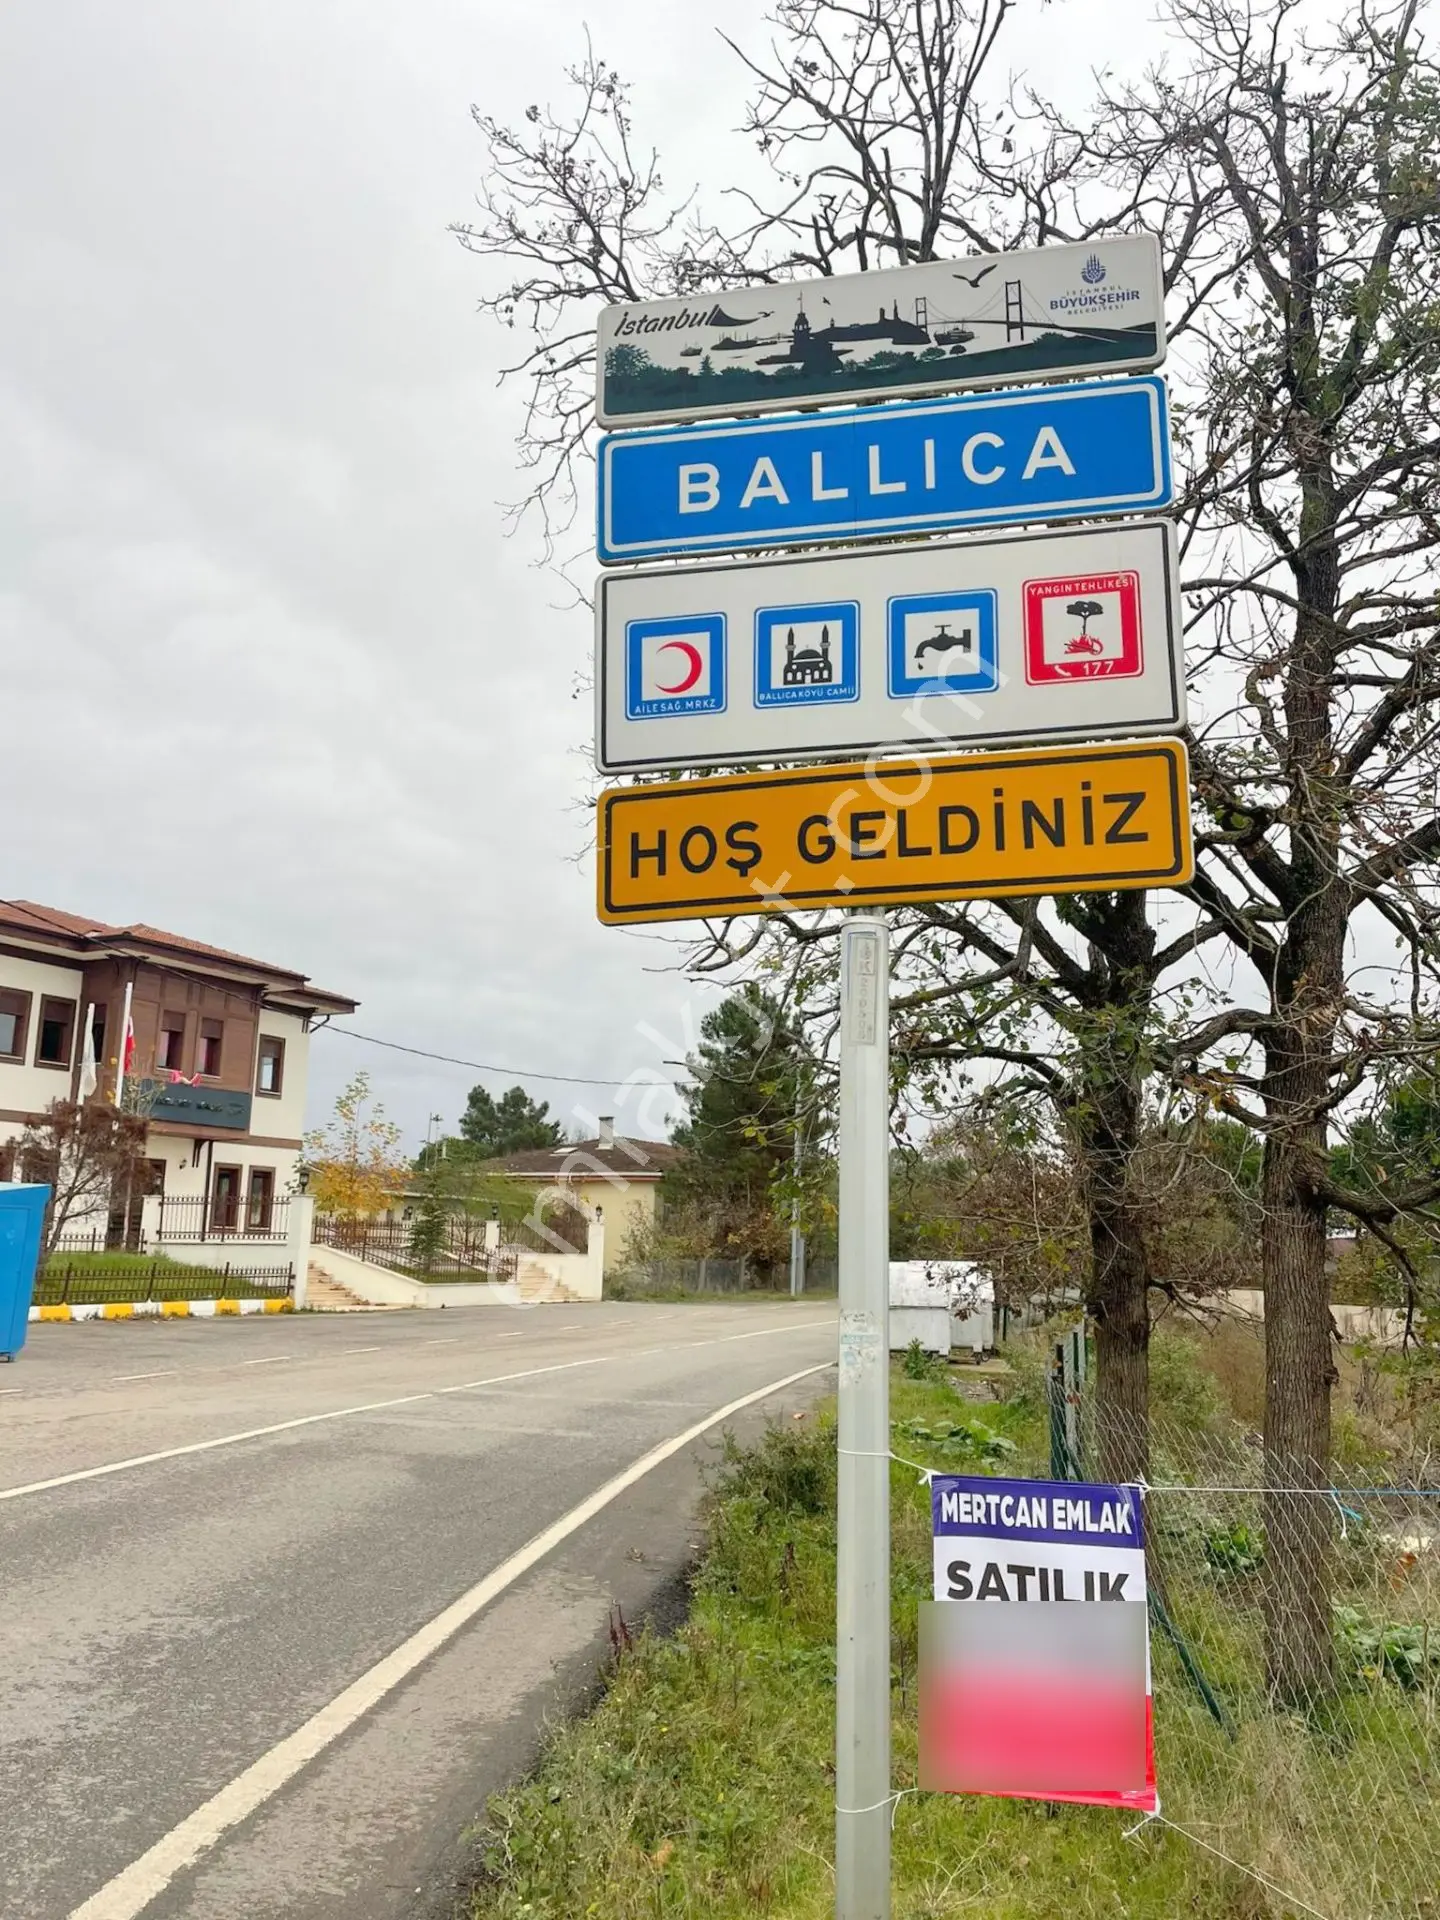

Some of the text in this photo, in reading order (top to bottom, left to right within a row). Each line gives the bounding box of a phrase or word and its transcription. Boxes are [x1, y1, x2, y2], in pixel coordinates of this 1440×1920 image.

[1050, 289, 1140, 310] BÜYÜKŞEHİR
[678, 426, 1077, 515] BALLICA
[1029, 584, 1072, 596] YANGIN
[1083, 661, 1114, 675] 177
[629, 780, 1149, 878] HOŞ GELDİNİZ
[941, 1491, 1133, 1535] MERTCAN EMLAK
[946, 1559, 1130, 1602] SATILIK
